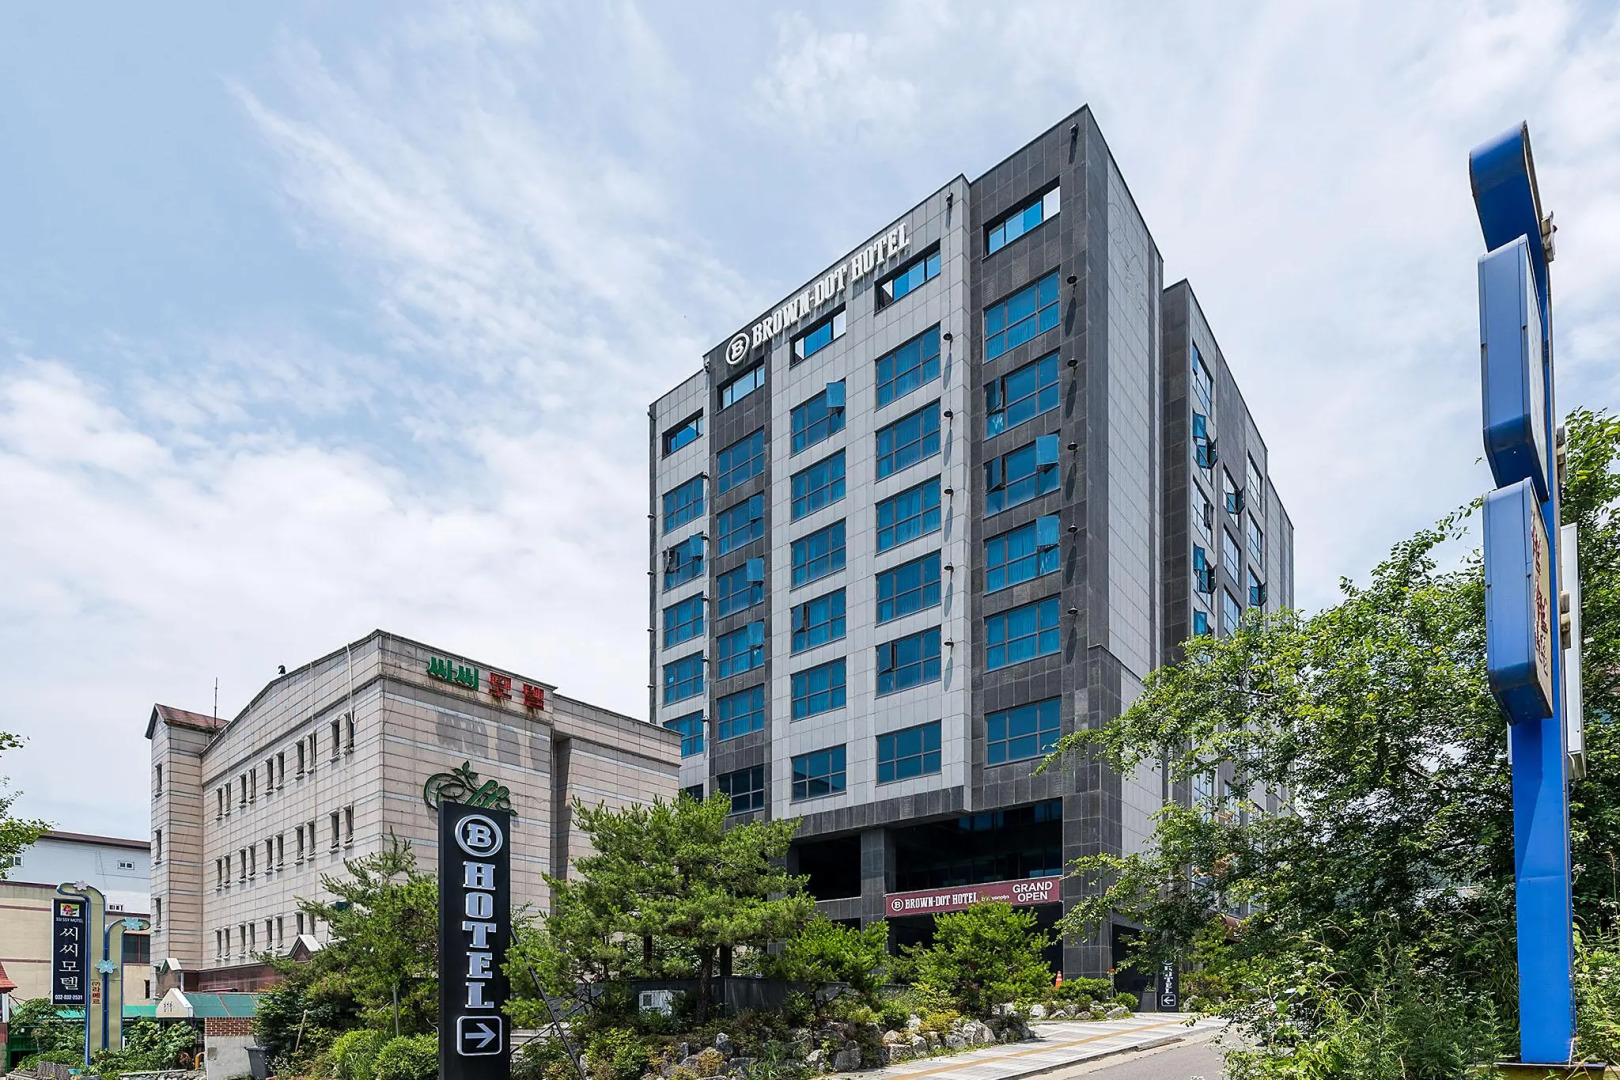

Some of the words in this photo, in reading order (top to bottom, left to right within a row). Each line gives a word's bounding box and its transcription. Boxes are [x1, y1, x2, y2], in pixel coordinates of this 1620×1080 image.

[752, 263, 847, 350] BROWN-DOT
[851, 222, 910, 280] HOTEL
[426, 656, 479, 691] 씨씨
[904, 896, 951, 910] BROWN-DOT
[952, 892, 979, 905] HOTEL
[1012, 881, 1053, 894] GRAND
[1017, 891, 1048, 902] OPEN
[462, 860, 497, 1009] HOTEL
[59, 926, 80, 991] 씨씨모텔
